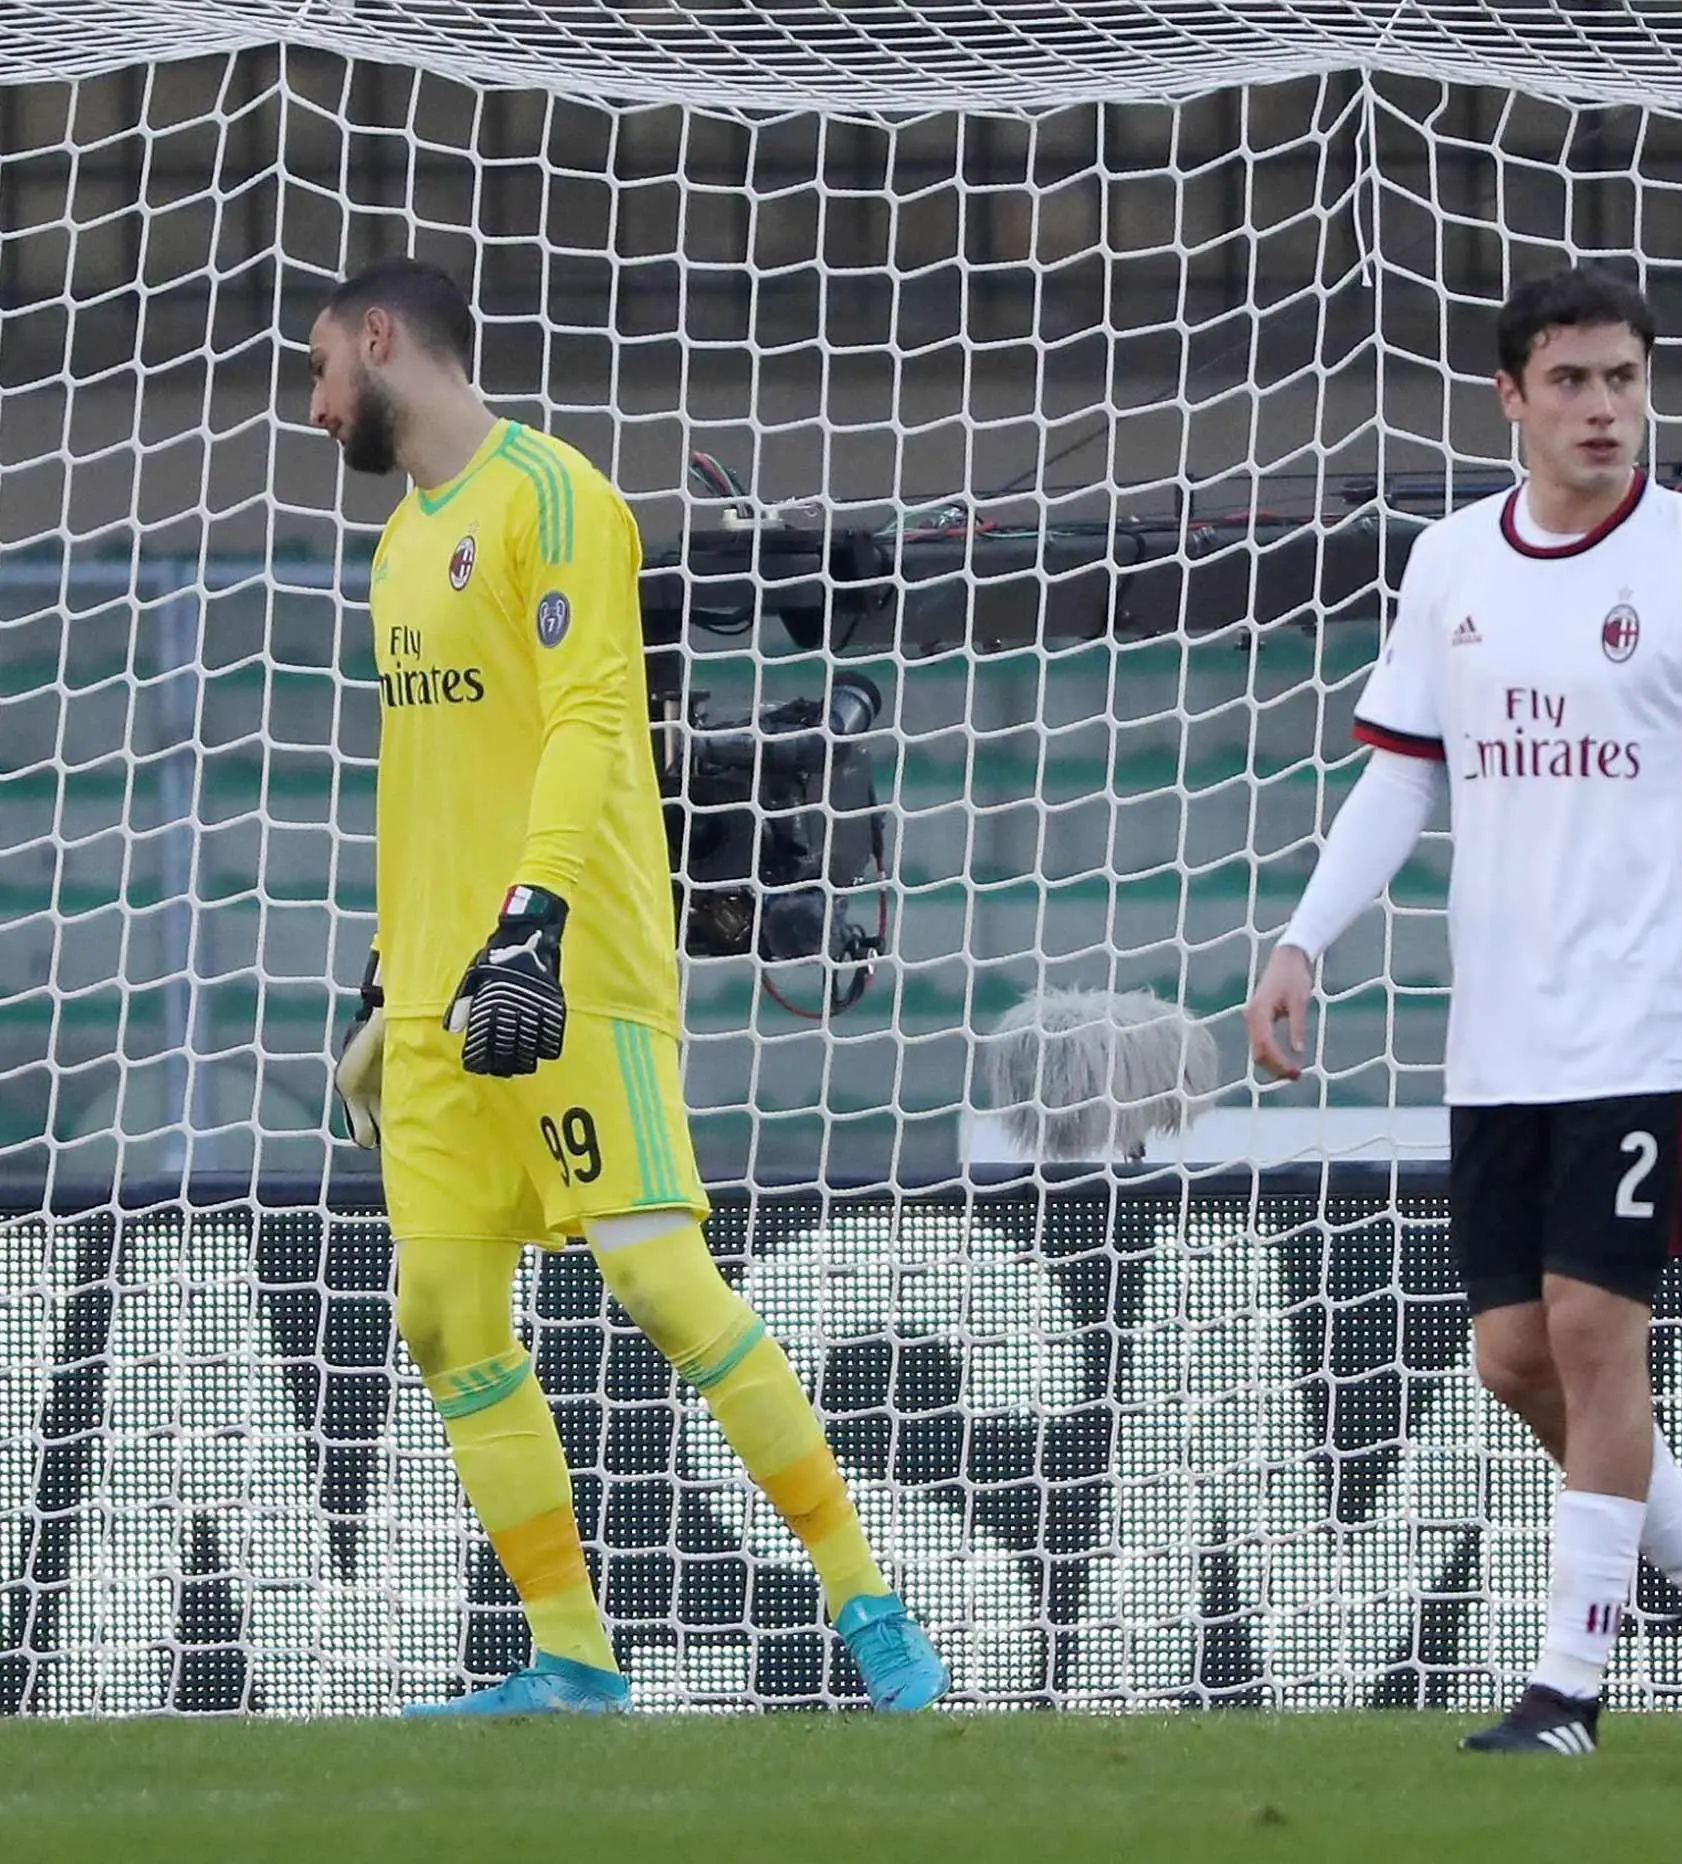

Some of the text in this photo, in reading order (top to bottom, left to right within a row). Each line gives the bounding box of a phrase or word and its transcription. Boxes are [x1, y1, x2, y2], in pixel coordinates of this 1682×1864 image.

[390, 625, 421, 661] Fly
[1506, 688, 1566, 728] Fly
[540, 1106, 602, 1189] 99
[1615, 1130, 1659, 1218] 2
